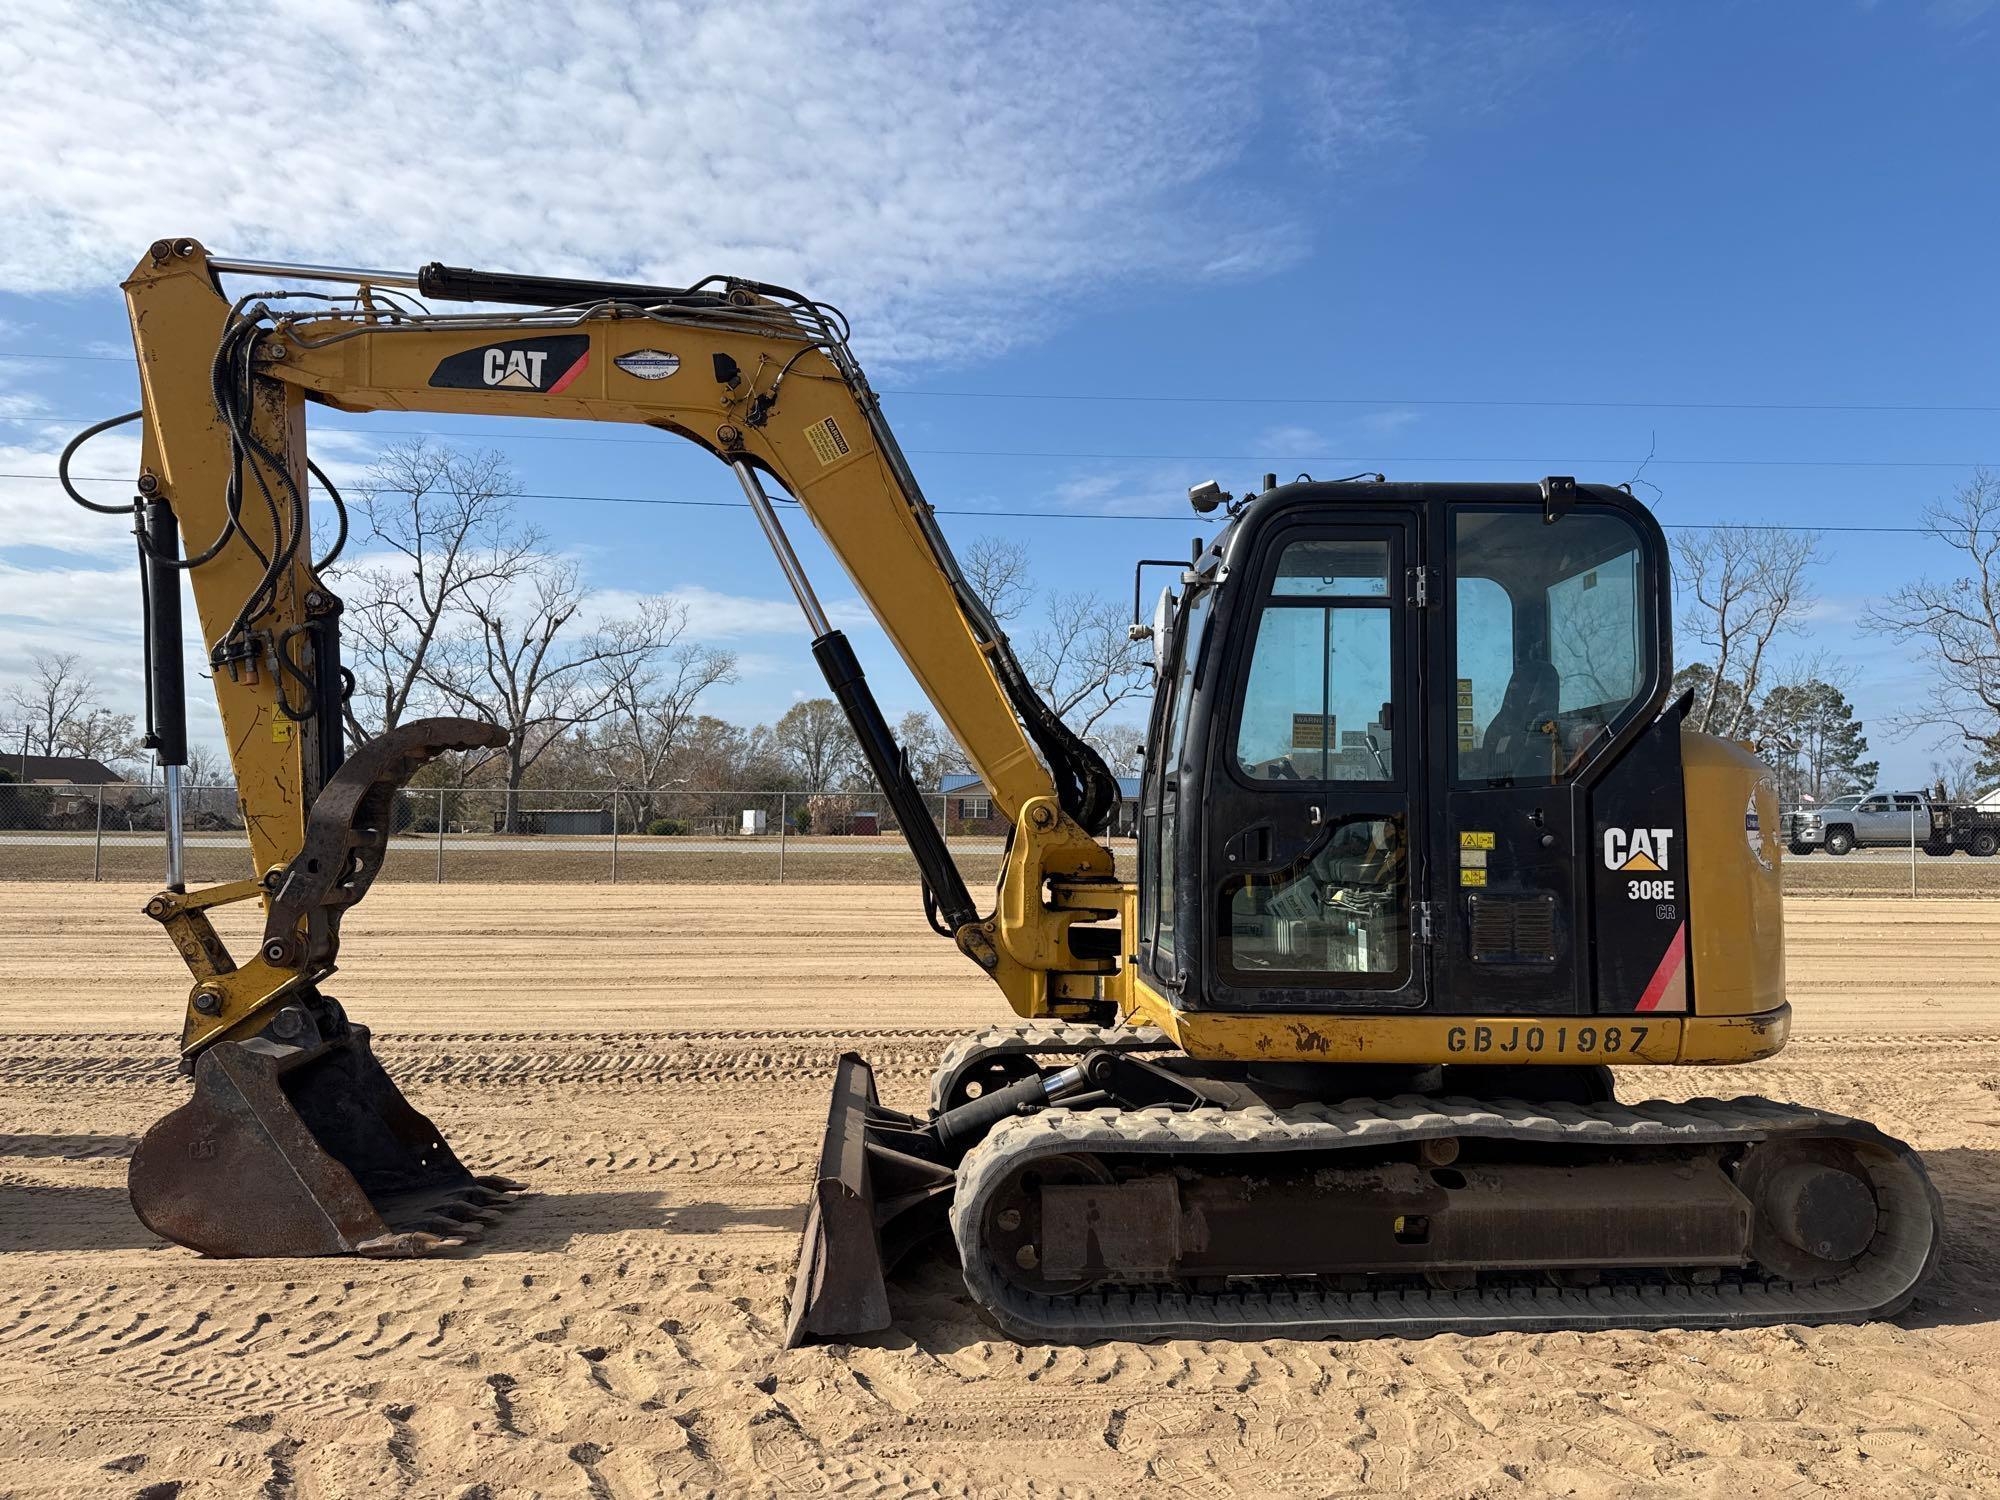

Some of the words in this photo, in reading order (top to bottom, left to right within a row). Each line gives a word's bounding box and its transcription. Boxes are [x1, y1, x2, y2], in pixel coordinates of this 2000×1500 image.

[483, 348, 548, 388] CAT
[826, 419, 849, 453] WARNING
[1604, 828, 1673, 870] CAT
[1628, 880, 1675, 900] 308E
[1656, 904, 1676, 920] CR
